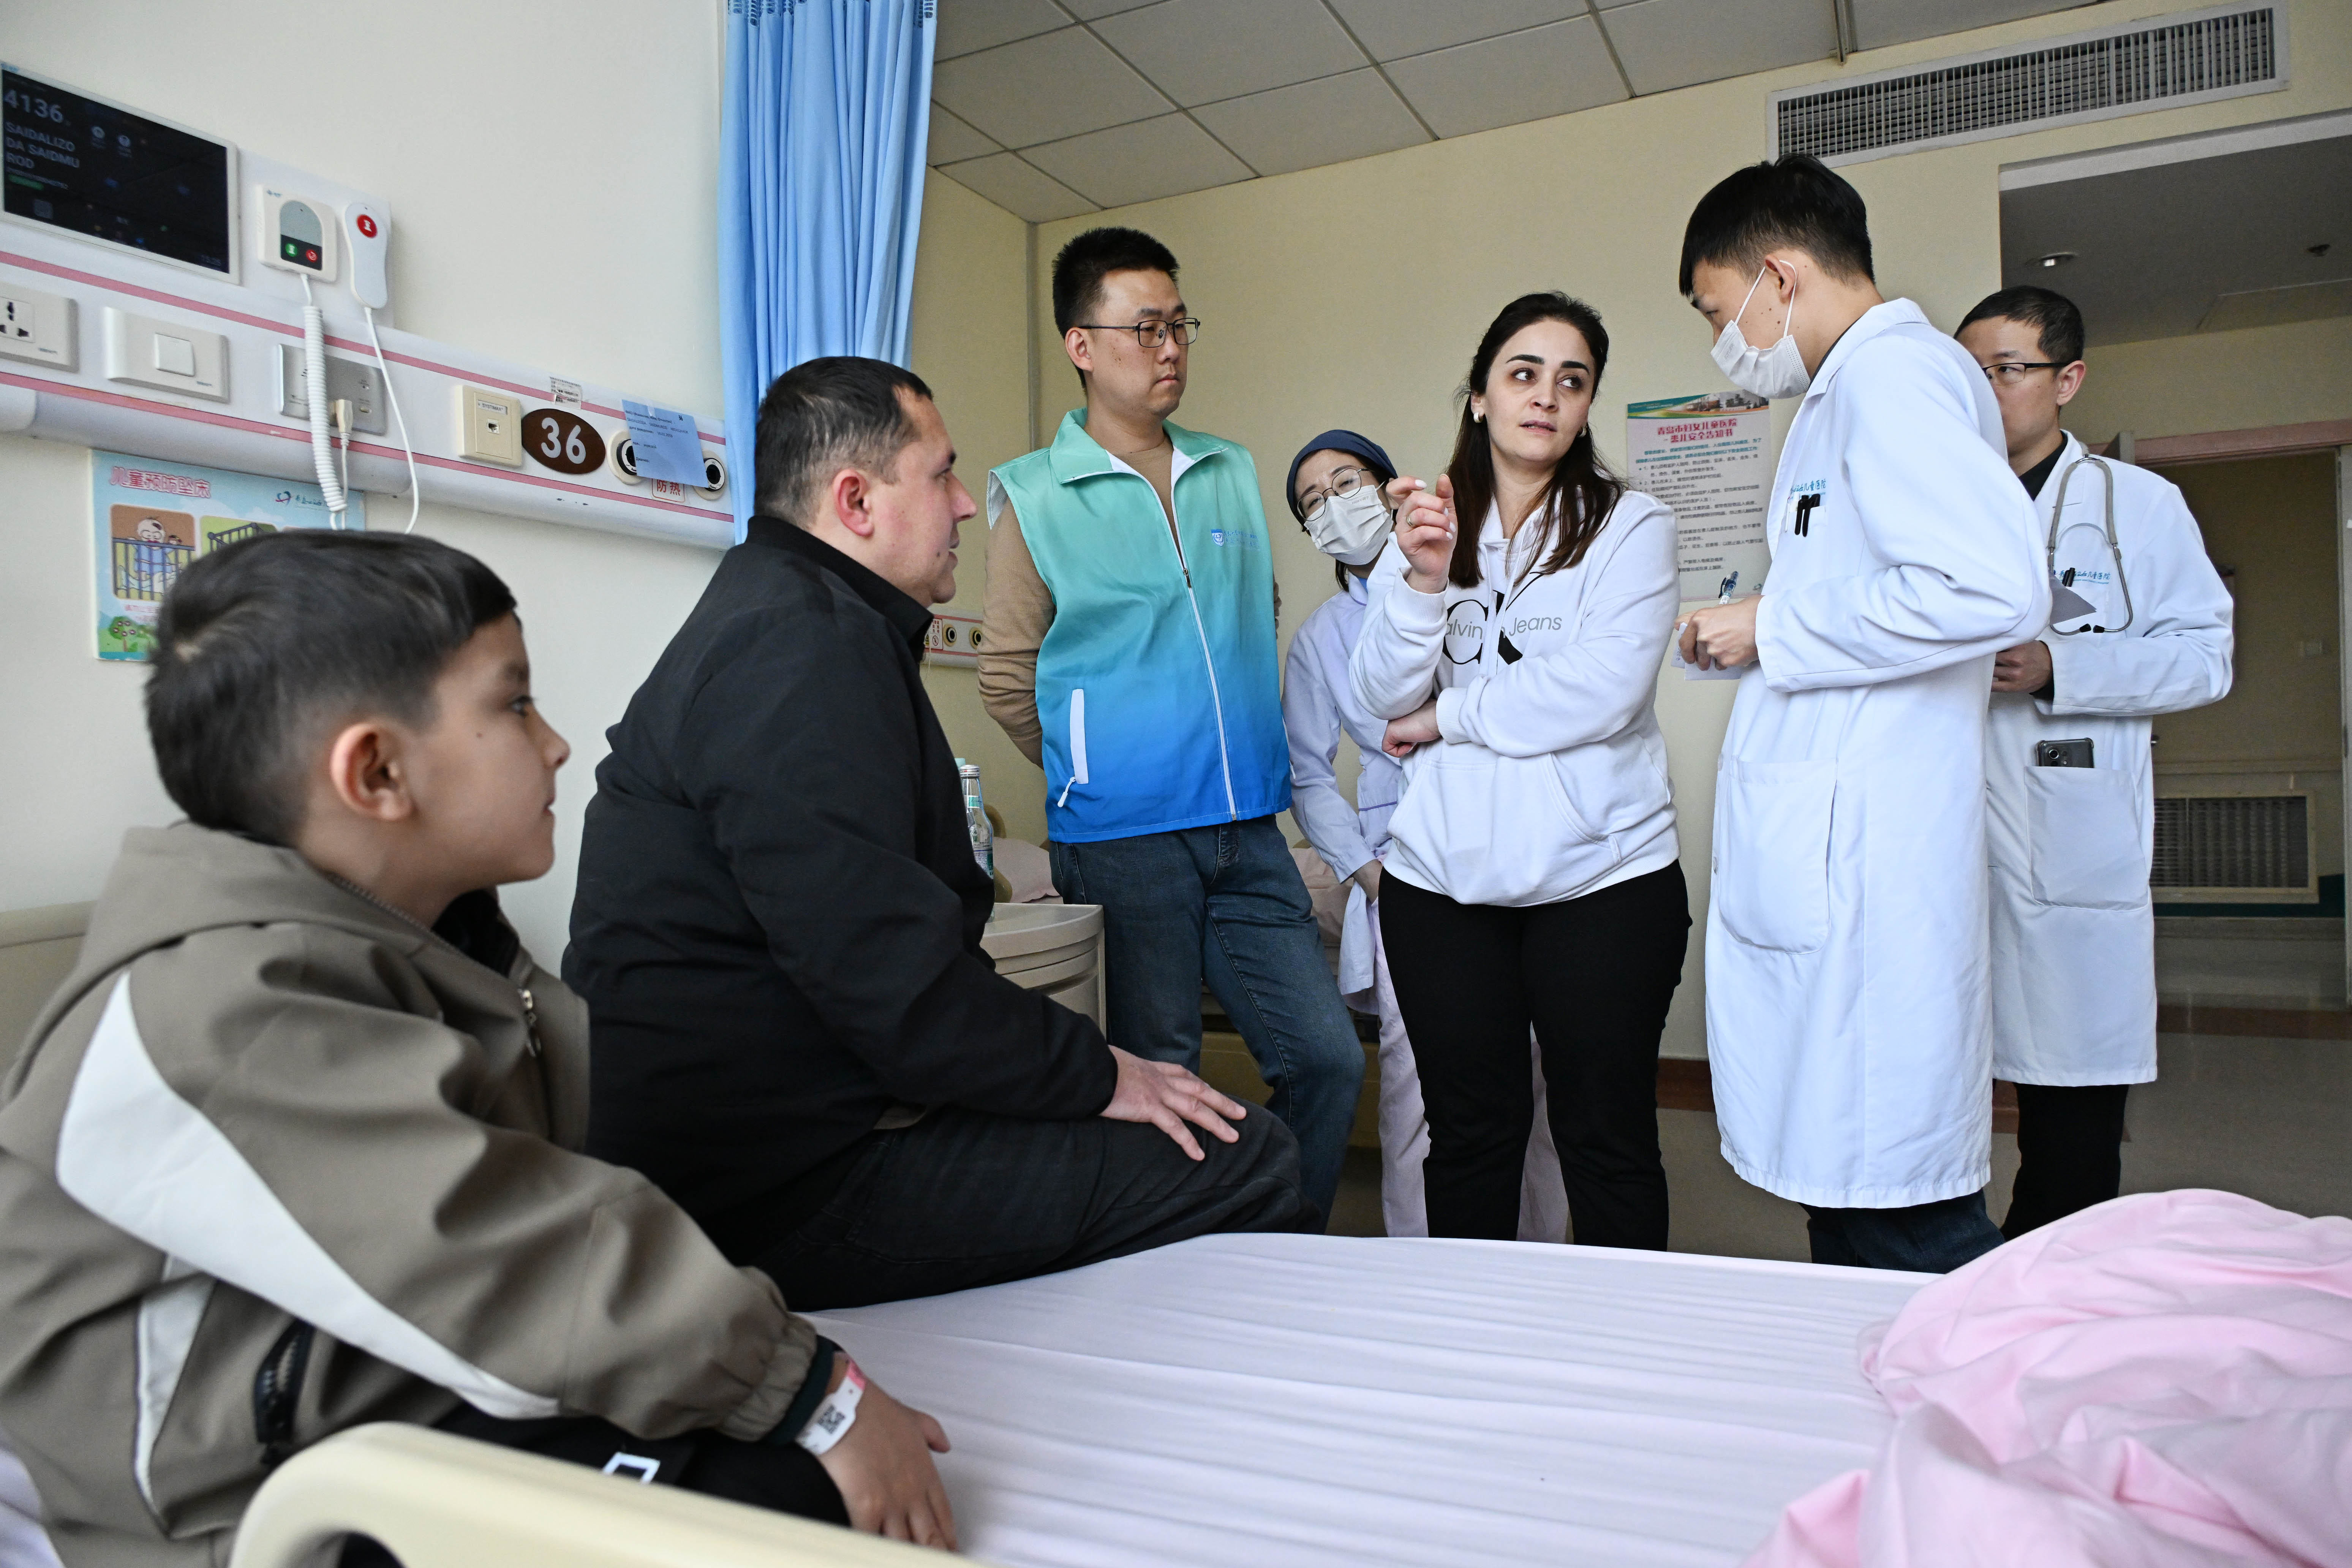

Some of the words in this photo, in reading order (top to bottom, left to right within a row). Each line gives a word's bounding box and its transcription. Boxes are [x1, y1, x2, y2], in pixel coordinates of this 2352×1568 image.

[4, 89, 63, 123] 4136
[6, 137, 25, 152] DA
[1658, 418, 1737, 435] 青岛市妇女儿童医院
[541, 417, 586, 464] 36
[110, 466, 211, 498] 儿童预防坠床
[657, 479, 681, 496] 防热
[1445, 619, 1483, 640] alvin
[1509, 617, 1562, 636] Jeans
